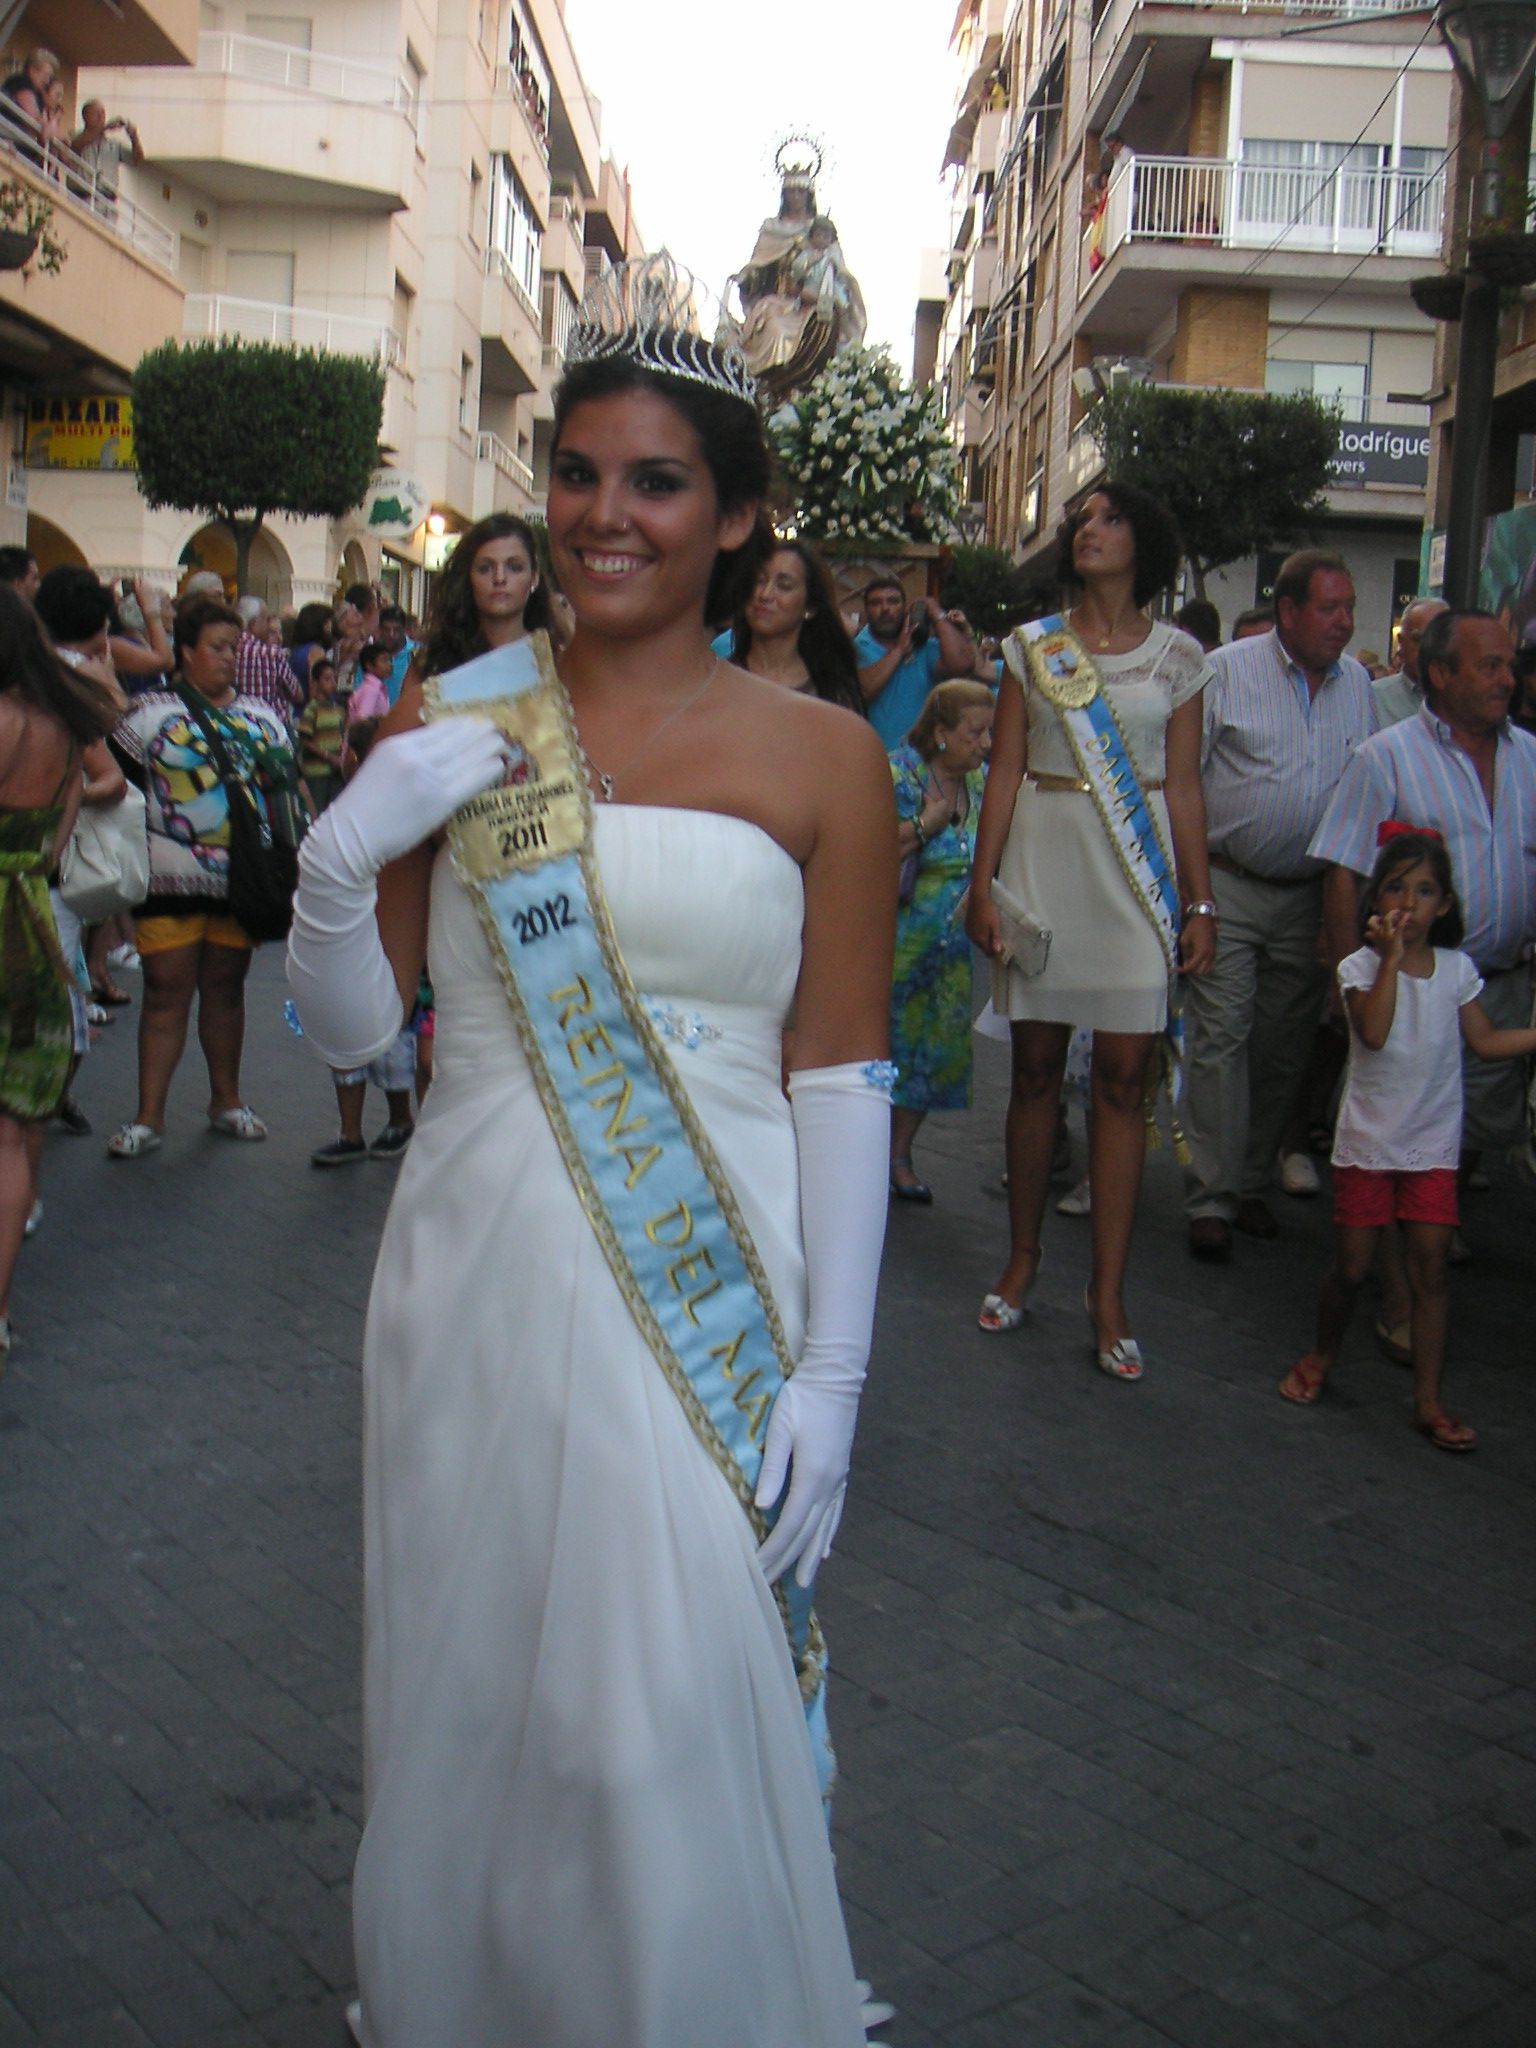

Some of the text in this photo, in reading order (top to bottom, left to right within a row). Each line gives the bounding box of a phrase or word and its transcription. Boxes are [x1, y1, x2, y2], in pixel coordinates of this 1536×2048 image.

[502, 818, 548, 858] 2011
[513, 895, 577, 945] 2012
[549, 973, 662, 1191] REINA
[644, 1199, 723, 1328] DEL
